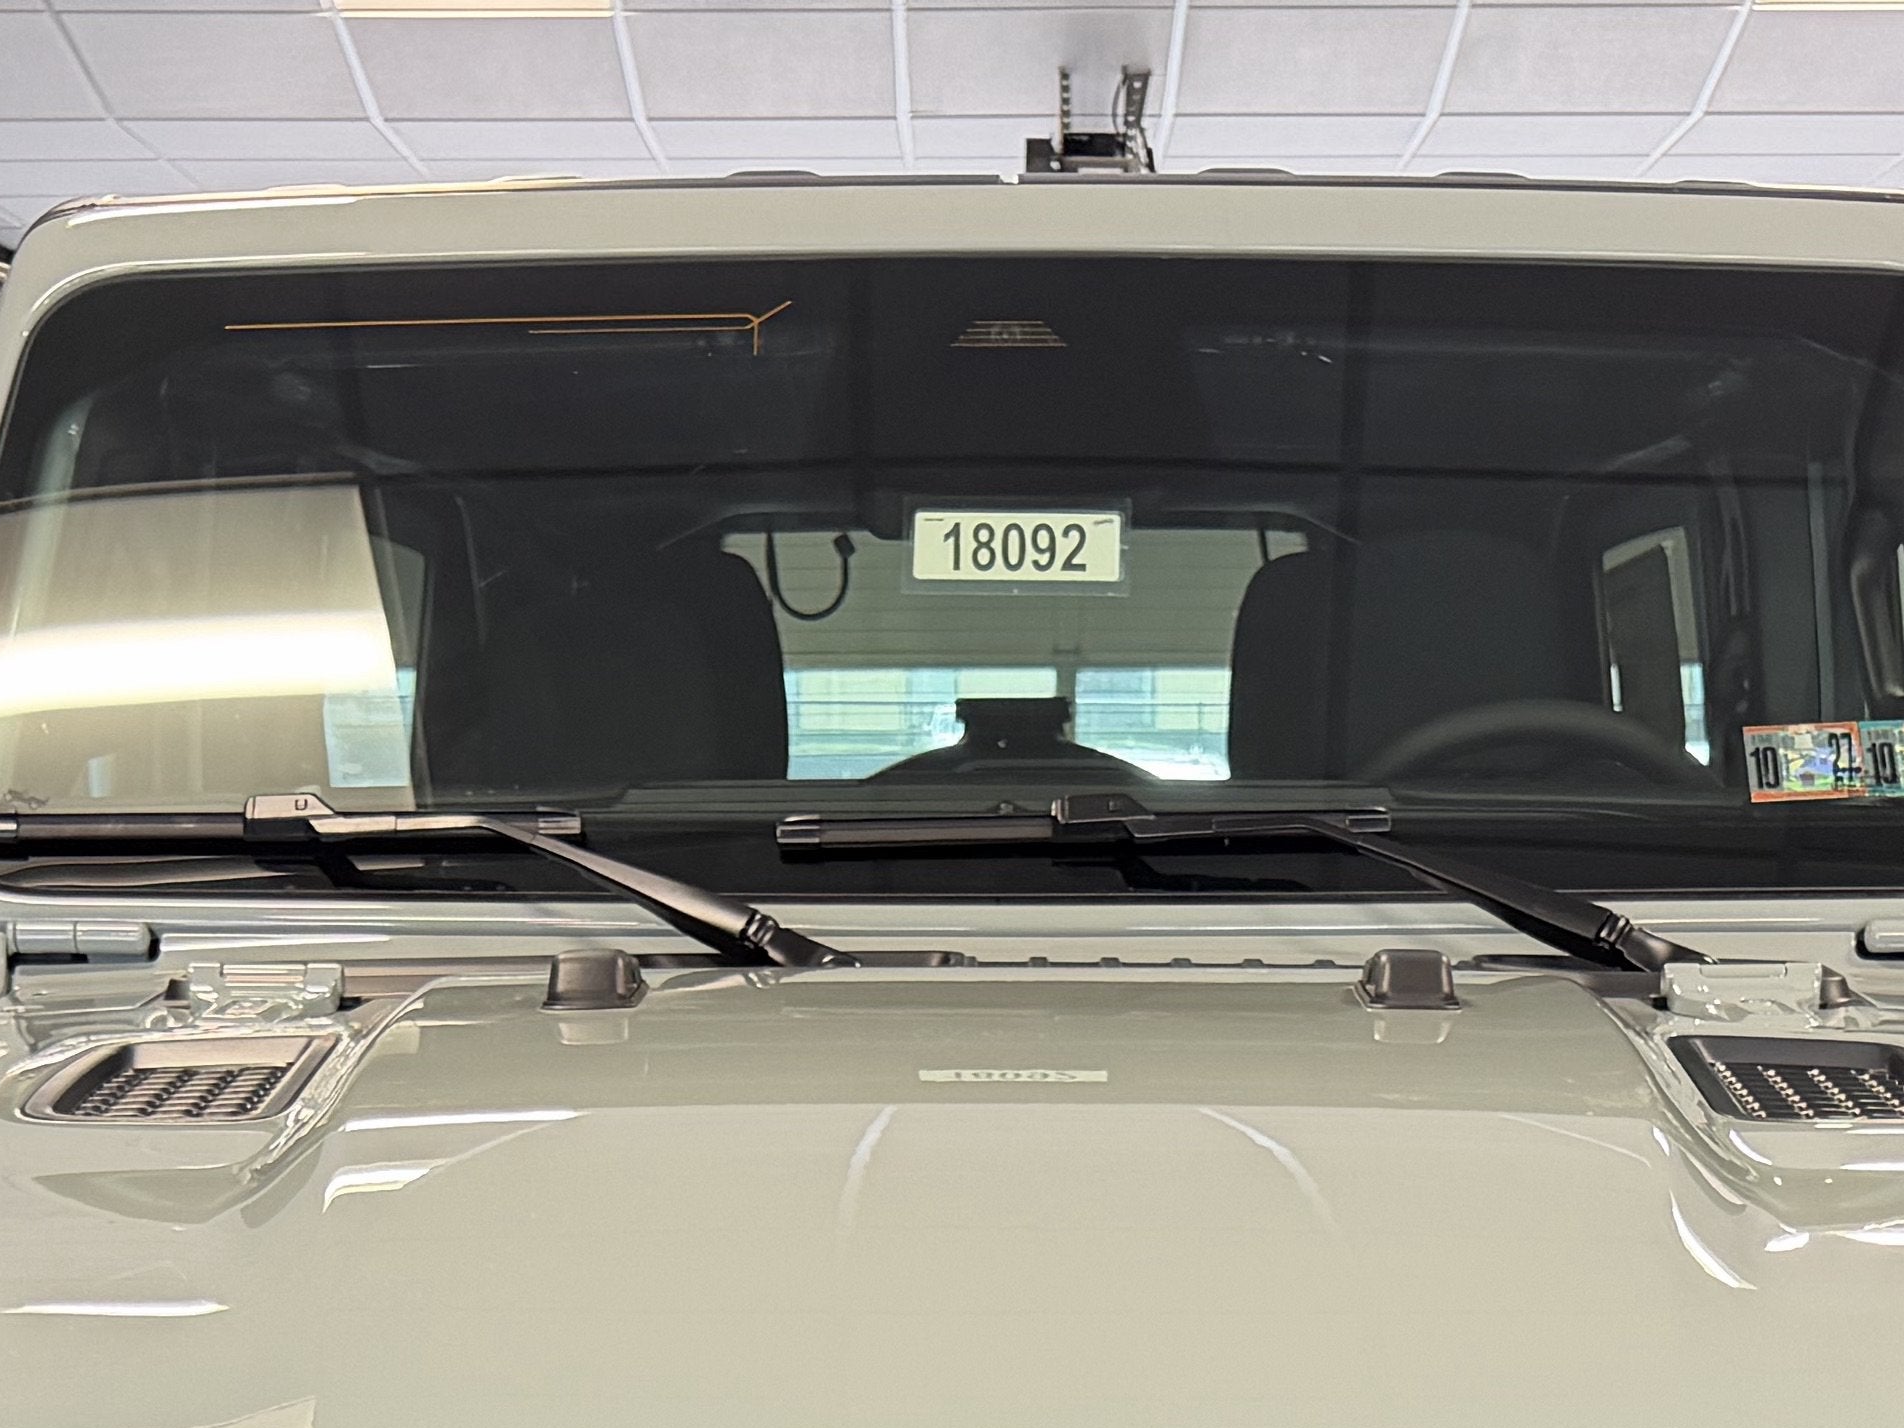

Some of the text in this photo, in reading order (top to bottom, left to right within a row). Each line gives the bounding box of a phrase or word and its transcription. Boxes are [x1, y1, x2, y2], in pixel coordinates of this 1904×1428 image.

[943, 522, 1087, 572] 18092
[1750, 746, 1780, 789] 10
[1867, 742, 1900, 785] 10
